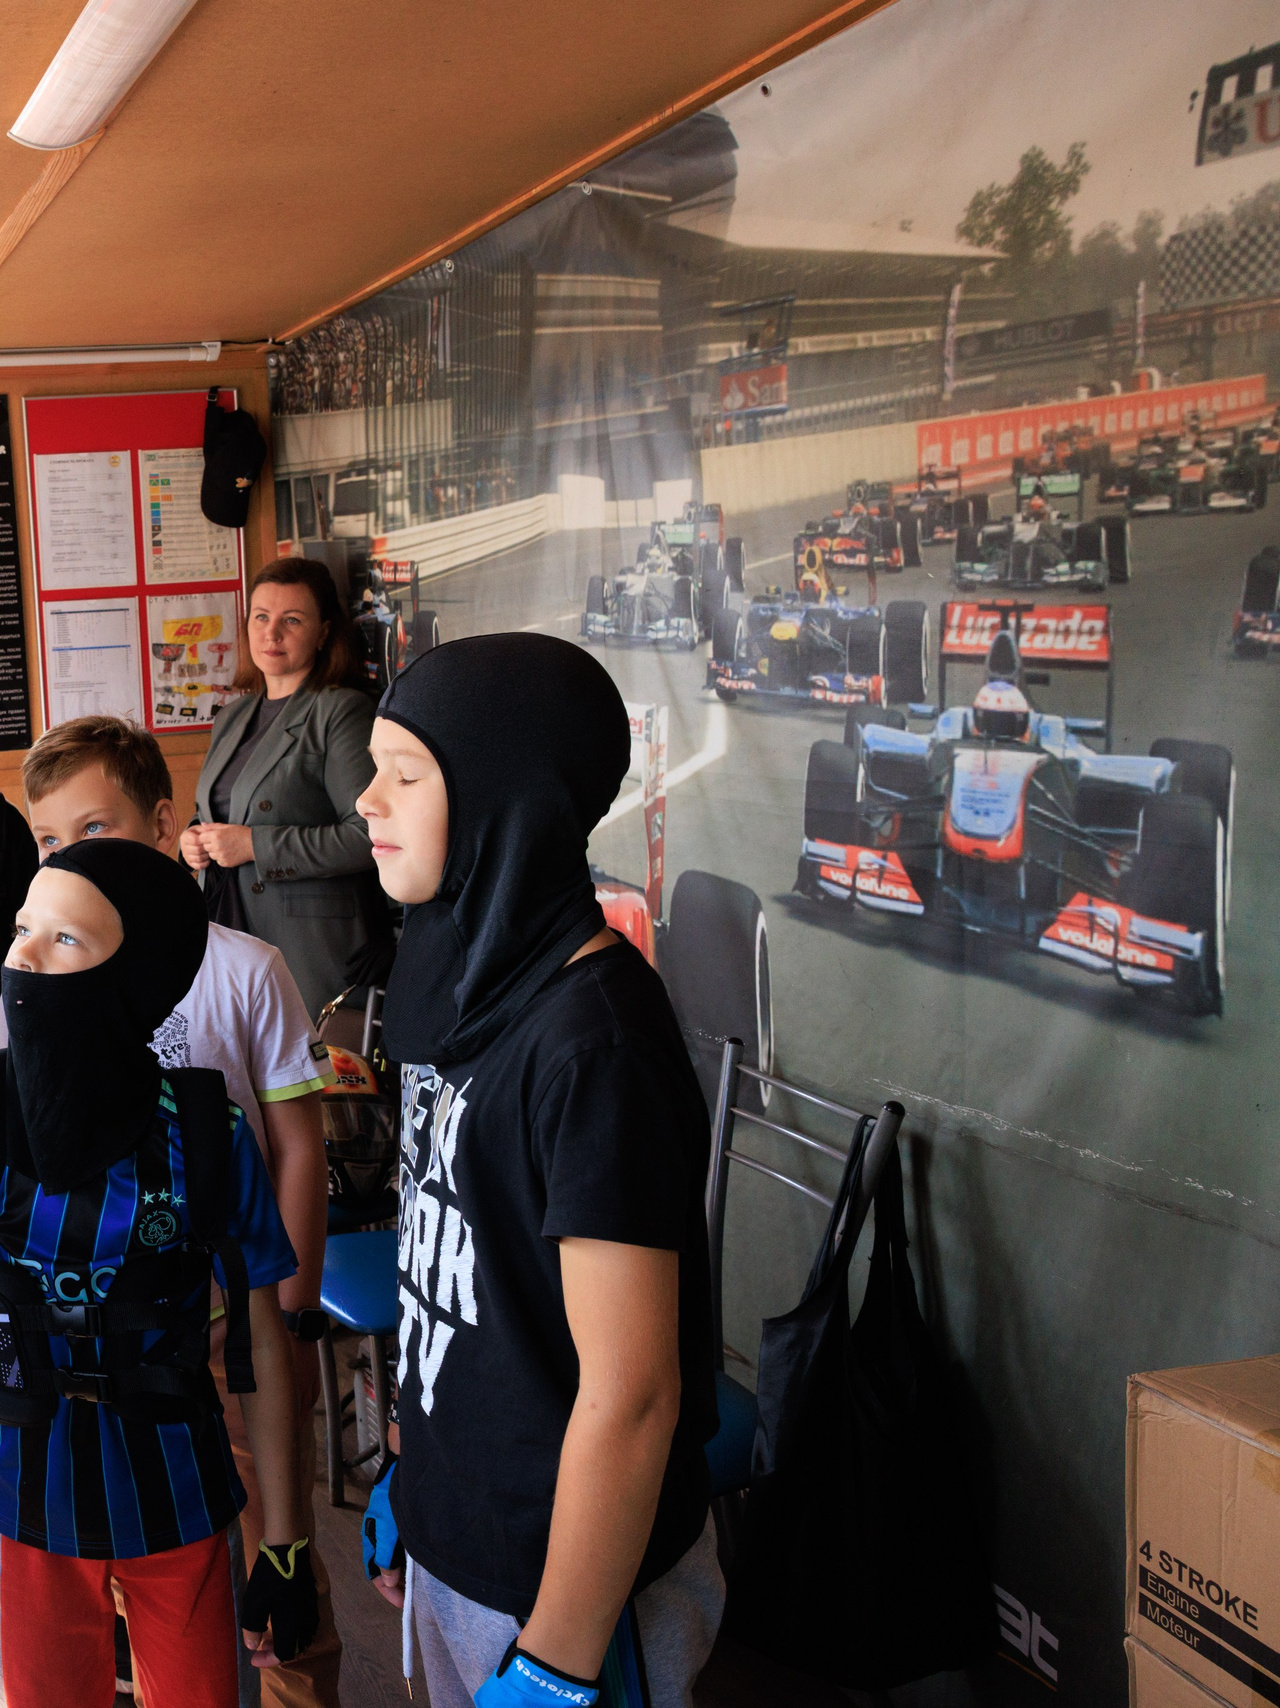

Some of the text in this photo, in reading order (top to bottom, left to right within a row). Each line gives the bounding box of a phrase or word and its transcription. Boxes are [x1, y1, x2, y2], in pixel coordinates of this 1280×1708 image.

[946, 605, 1105, 651] Luczade
[830, 869, 910, 900] vodafone
[161, 1041, 187, 1060] t-rex
[139, 1210, 159, 1230] AJAX
[1139, 1540, 1259, 1631] 4 STROKE
[1147, 1571, 1200, 1619] Engine
[1146, 1600, 1200, 1649] Moteur
[515, 1659, 591, 1707] cyclotech
